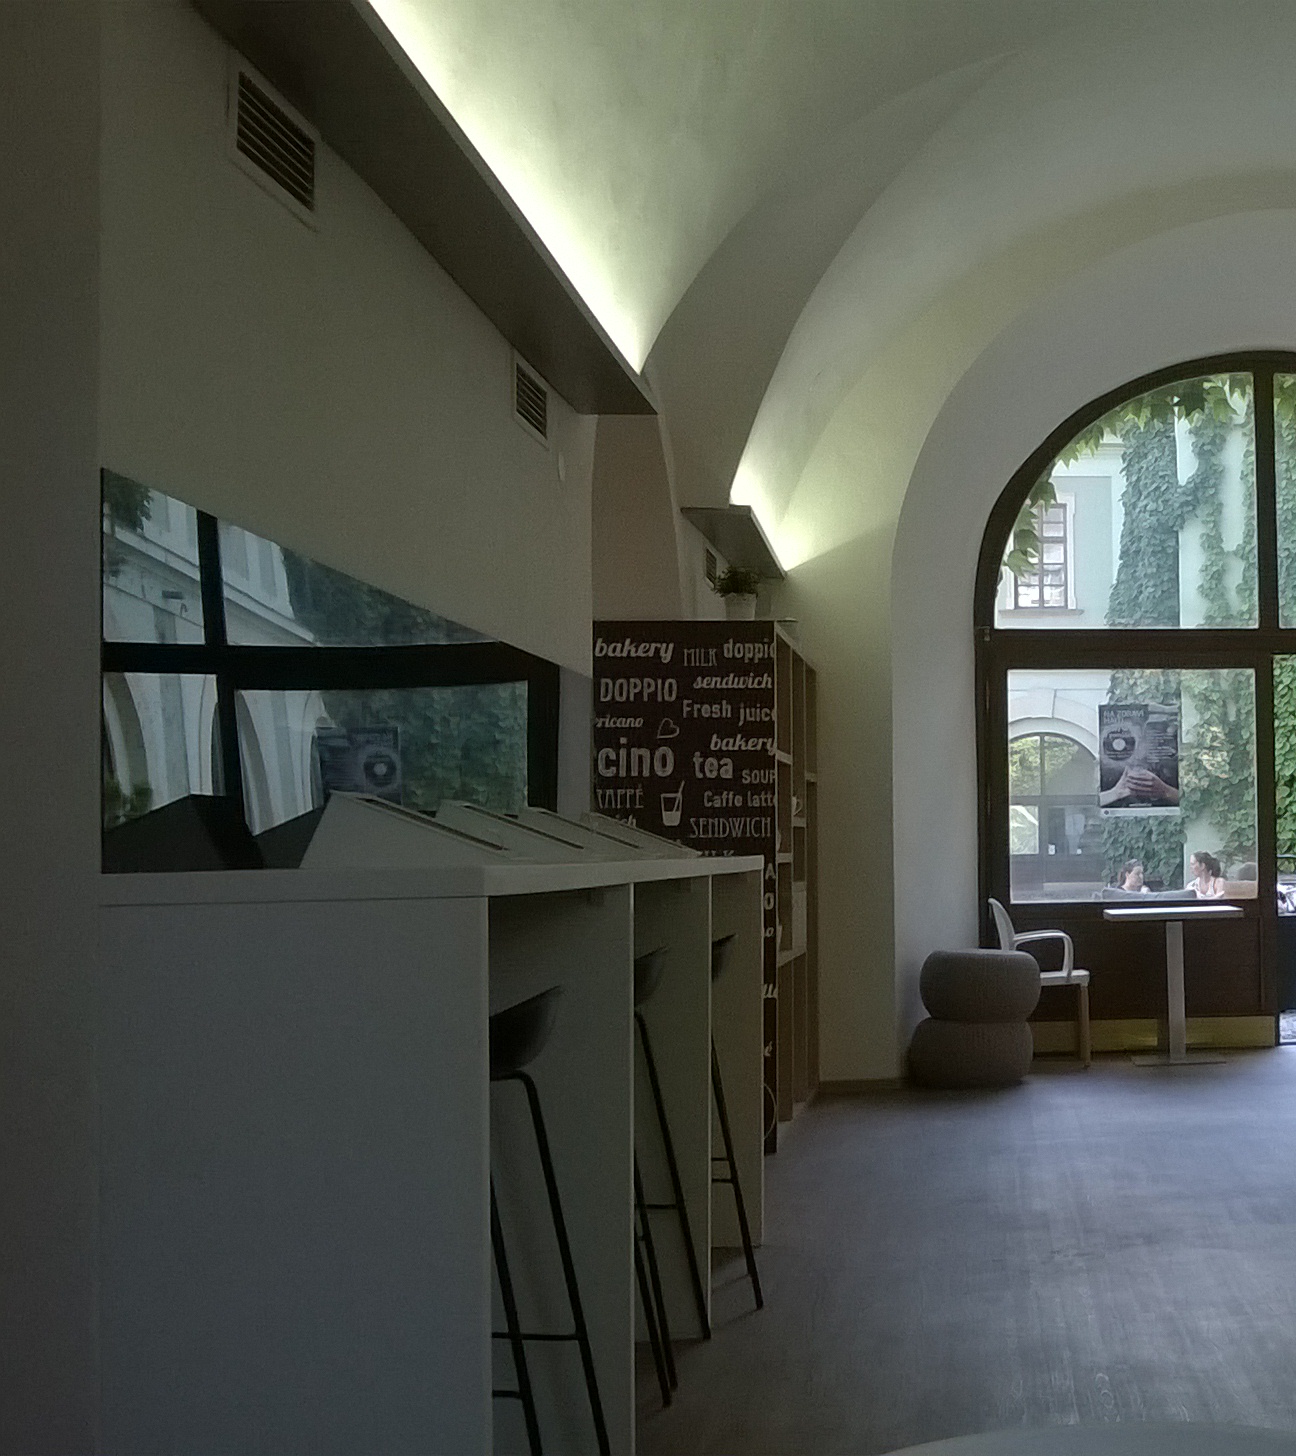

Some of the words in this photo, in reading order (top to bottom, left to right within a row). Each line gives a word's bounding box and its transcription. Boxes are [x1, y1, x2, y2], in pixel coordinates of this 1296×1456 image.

[595, 637, 675, 664] bakery
[683, 648, 718, 667] MILK
[600, 678, 678, 703] DOPPIO
[693, 672, 772, 690] sendwich
[683, 700, 732, 719] Fresh
[596, 715, 644, 729] ricano
[710, 733, 777, 756] bakery
[597, 737, 675, 778] cino
[693, 752, 734, 779] tea
[703, 791, 743, 808] Caffe
[747, 791, 775, 807] latt
[689, 817, 772, 839] SENDWICH
